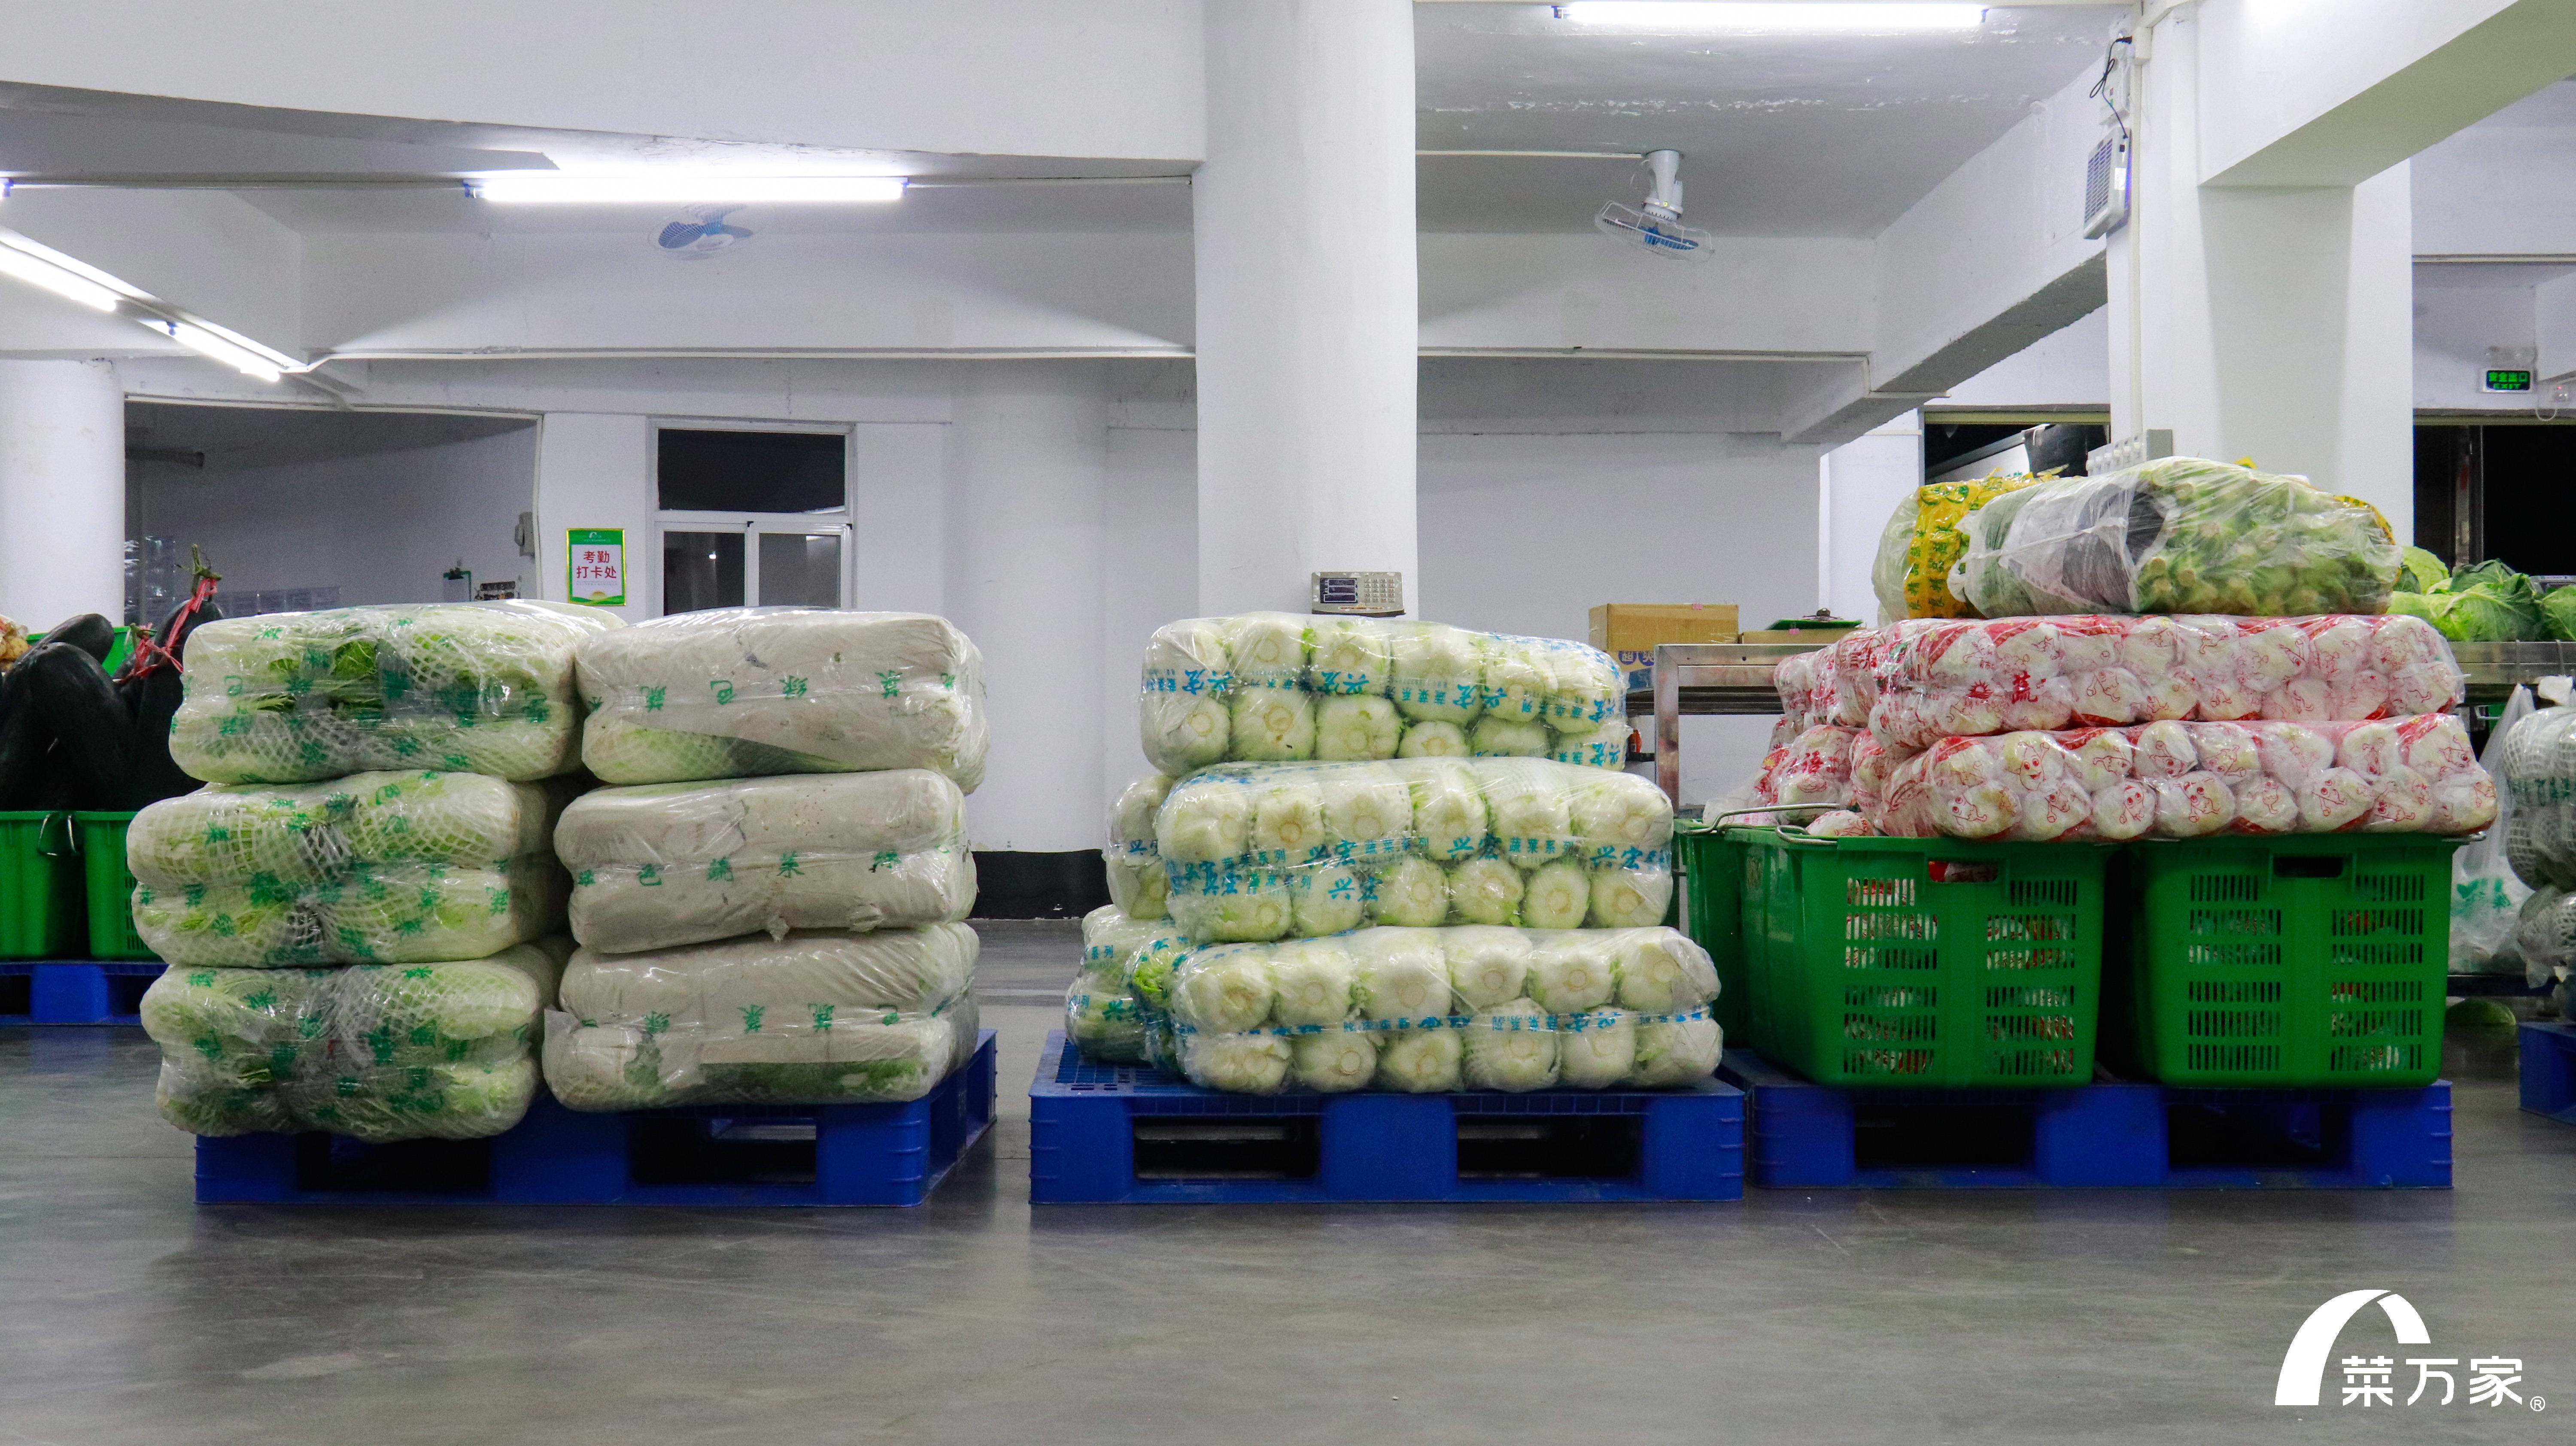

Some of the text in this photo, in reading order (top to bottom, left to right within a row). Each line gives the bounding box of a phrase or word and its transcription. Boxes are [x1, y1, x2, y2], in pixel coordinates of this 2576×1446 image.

[583, 550, 610, 563] 考勤
[576, 565, 617, 579] 打卡处
[1316, 671, 1370, 695] 兴宏
[2011, 671, 2038, 705] 蔬
[1453, 684, 1507, 710] 兴宏
[1589, 845, 1643, 870] 兴宏
[1328, 876, 1383, 902] 兴宏
